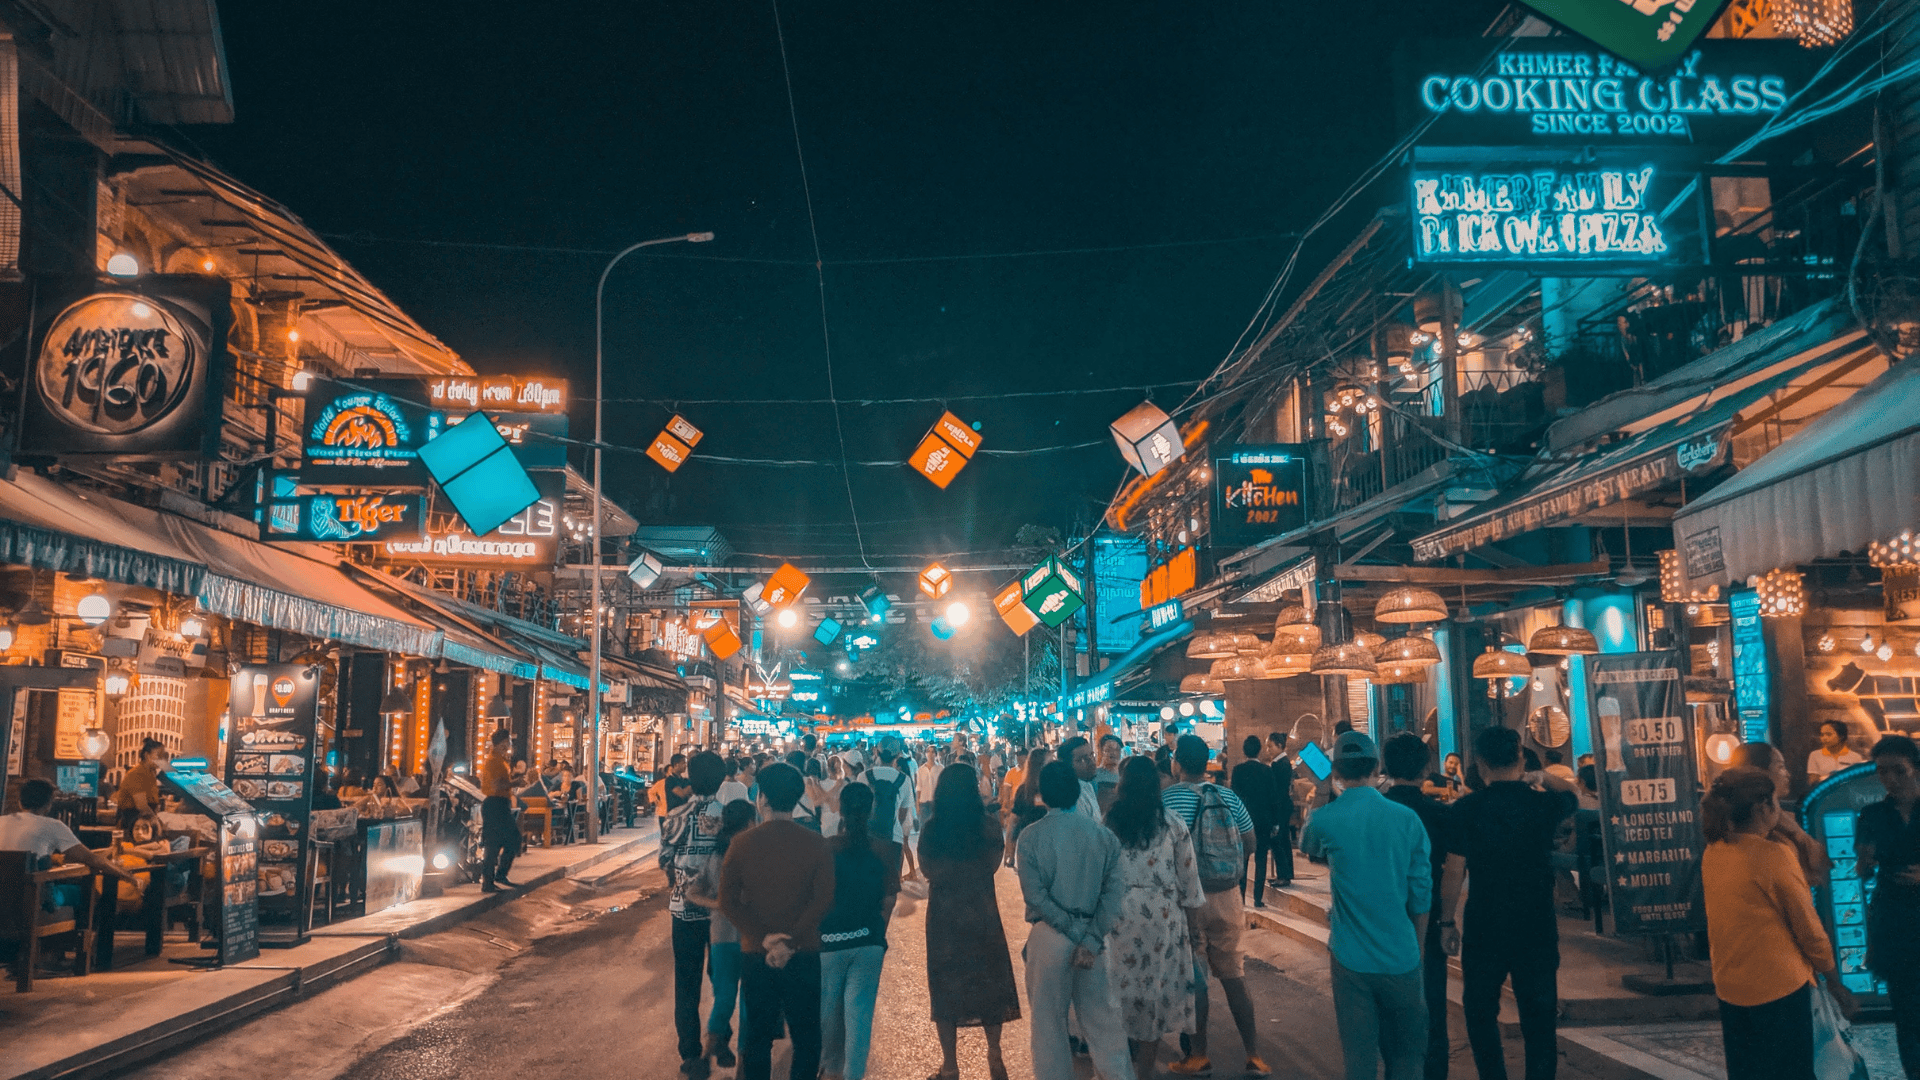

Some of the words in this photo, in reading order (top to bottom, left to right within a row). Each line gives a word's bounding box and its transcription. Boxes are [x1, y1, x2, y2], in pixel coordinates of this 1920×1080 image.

[1499, 53, 1594, 77] KHMER
[1422, 77, 1627, 112] COOKING
[1638, 78, 1787, 113] CLASS
[1532, 114, 1612, 134] SINCE
[1617, 115, 1687, 134] 2002
[1414, 175, 1533, 214] KHMER
[1534, 168, 1653, 212] FAMILY
[1579, 212, 1668, 254] PIZZA
[61, 351, 167, 423] 1960
[447, 380, 478, 407] daily
[943, 421, 975, 448] TEMPLE
[655, 441, 682, 464] TEMPLE
[924, 446, 951, 475] TEMPLE
[1677, 434, 1718, 469] Carlsberg
[336, 497, 408, 532] Tiger
[1541, 487, 1583, 520] FAMILY
[1629, 721, 1676, 741] $0.50
[1627, 782, 1668, 802] $1.75
[1623, 812, 1654, 827] LONG
[1655, 809, 1694, 825] ISLAND
[1625, 828, 1651, 842] ICED
[1653, 826, 1674, 840] TEA
[1627, 847, 1692, 864] MARGARITA
[1630, 872, 1671, 888] MOJITO
